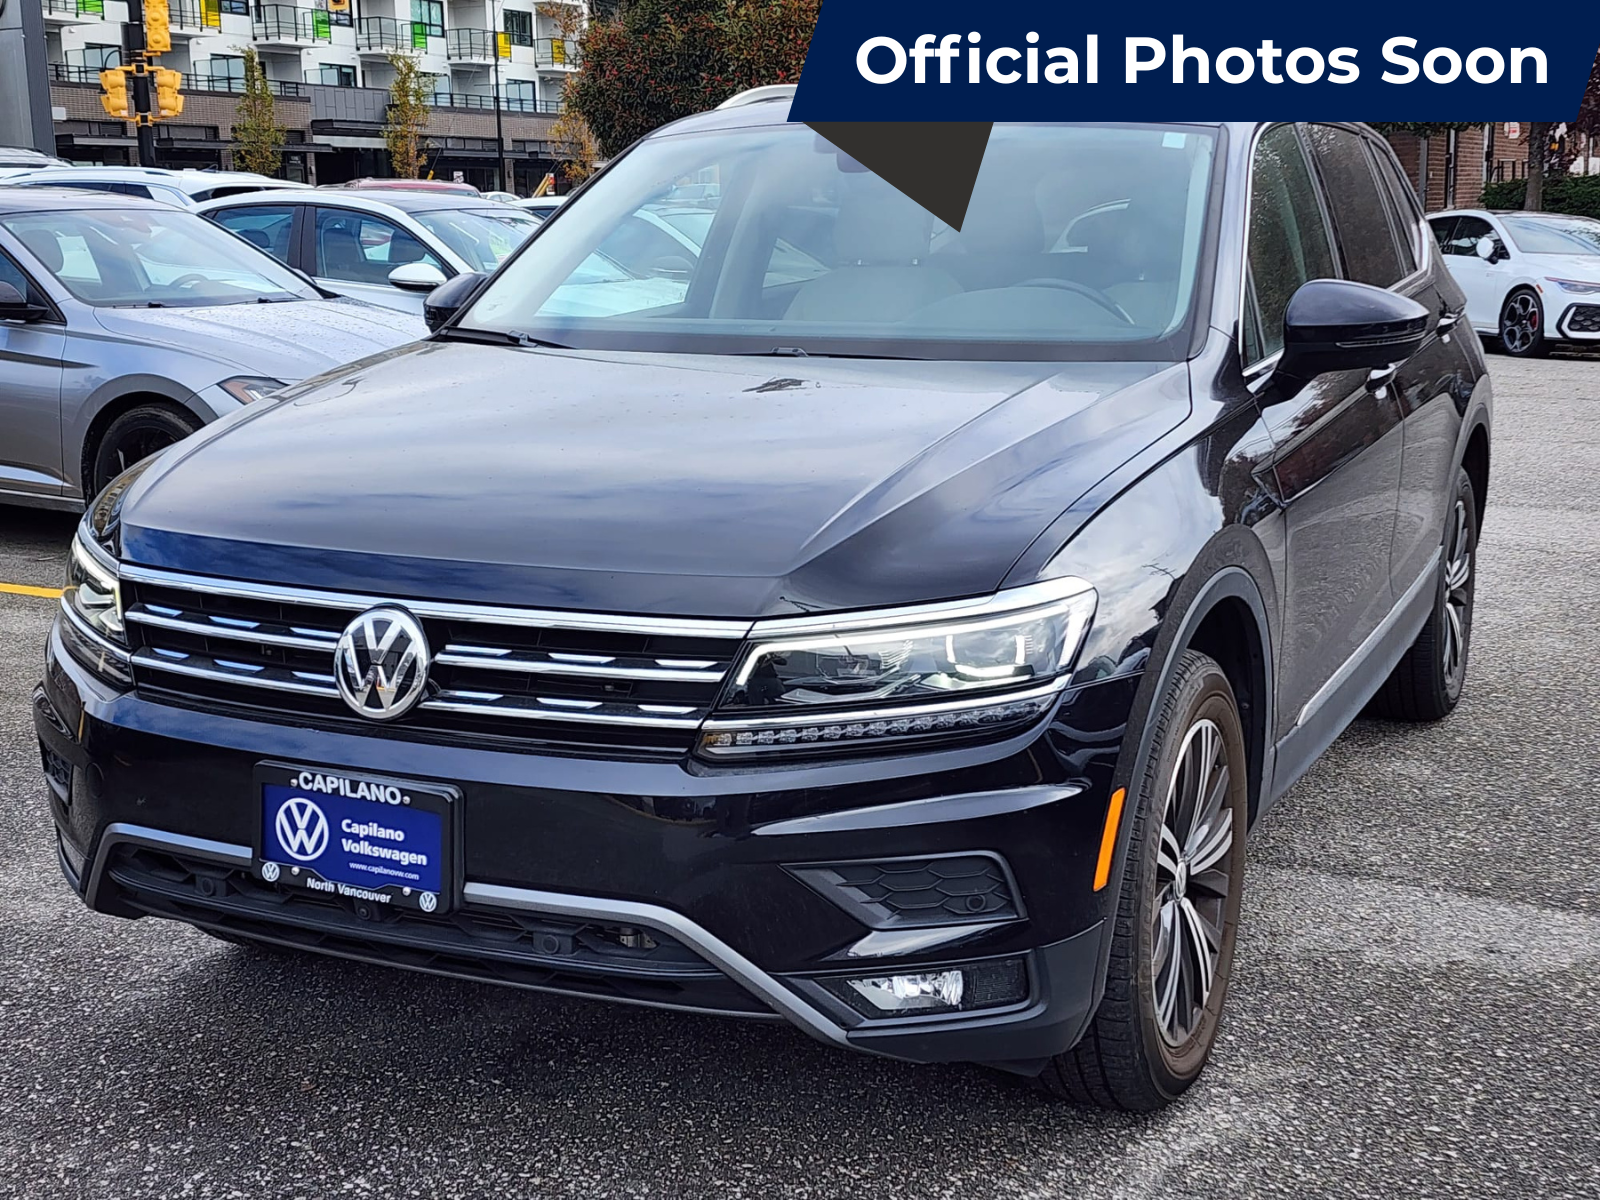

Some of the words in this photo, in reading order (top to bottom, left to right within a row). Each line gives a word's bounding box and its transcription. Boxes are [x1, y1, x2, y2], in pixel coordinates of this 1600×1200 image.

[299, 771, 402, 806] CAPILANO
[277, 798, 328, 860] VW
[341, 818, 405, 842] Capilano
[341, 838, 428, 866] Volkswagen
[306, 877, 335, 893] North
[337, 883, 392, 904] Vancouver
